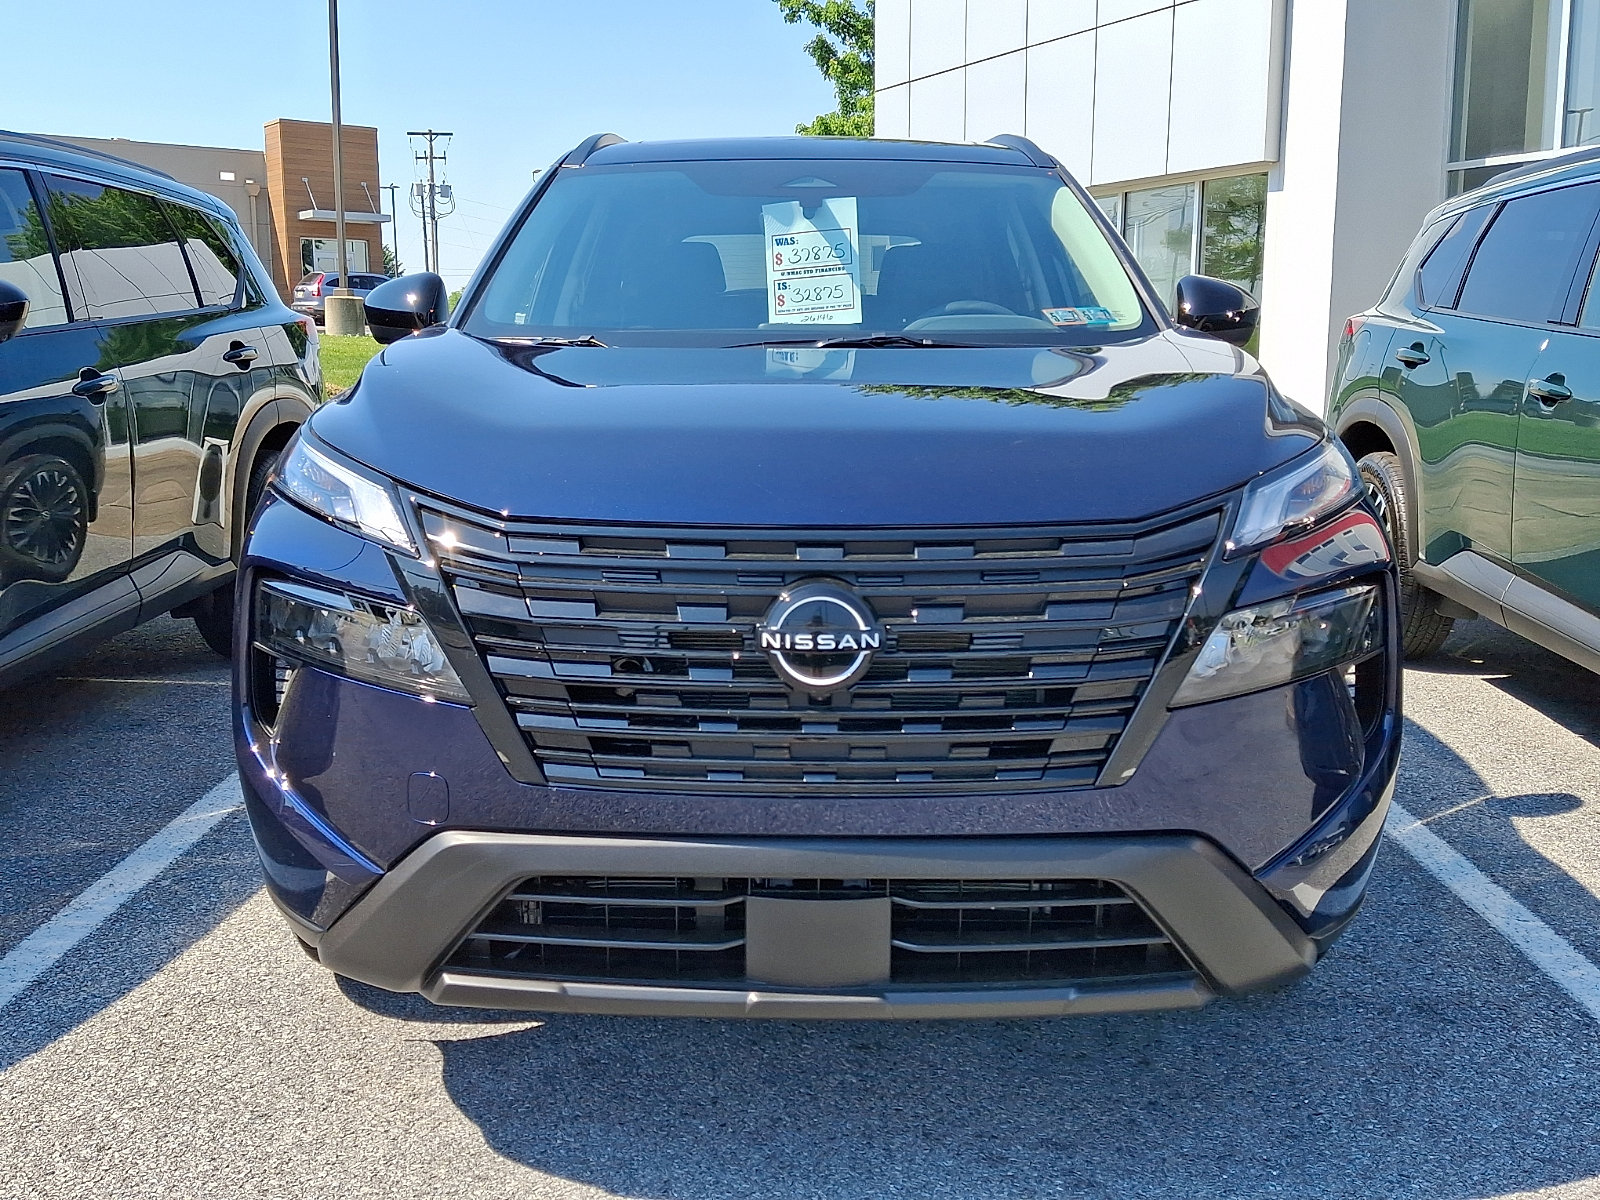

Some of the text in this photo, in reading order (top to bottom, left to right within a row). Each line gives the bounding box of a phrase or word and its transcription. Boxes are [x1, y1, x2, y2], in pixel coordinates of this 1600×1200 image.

[775, 237, 799, 247] WAS:
[775, 242, 846, 266] $ 37875
[815, 266, 845, 274] FINANCING
[777, 282, 791, 290] IS:
[777, 284, 844, 307] $ 32875
[761, 632, 880, 650] NISSAN
